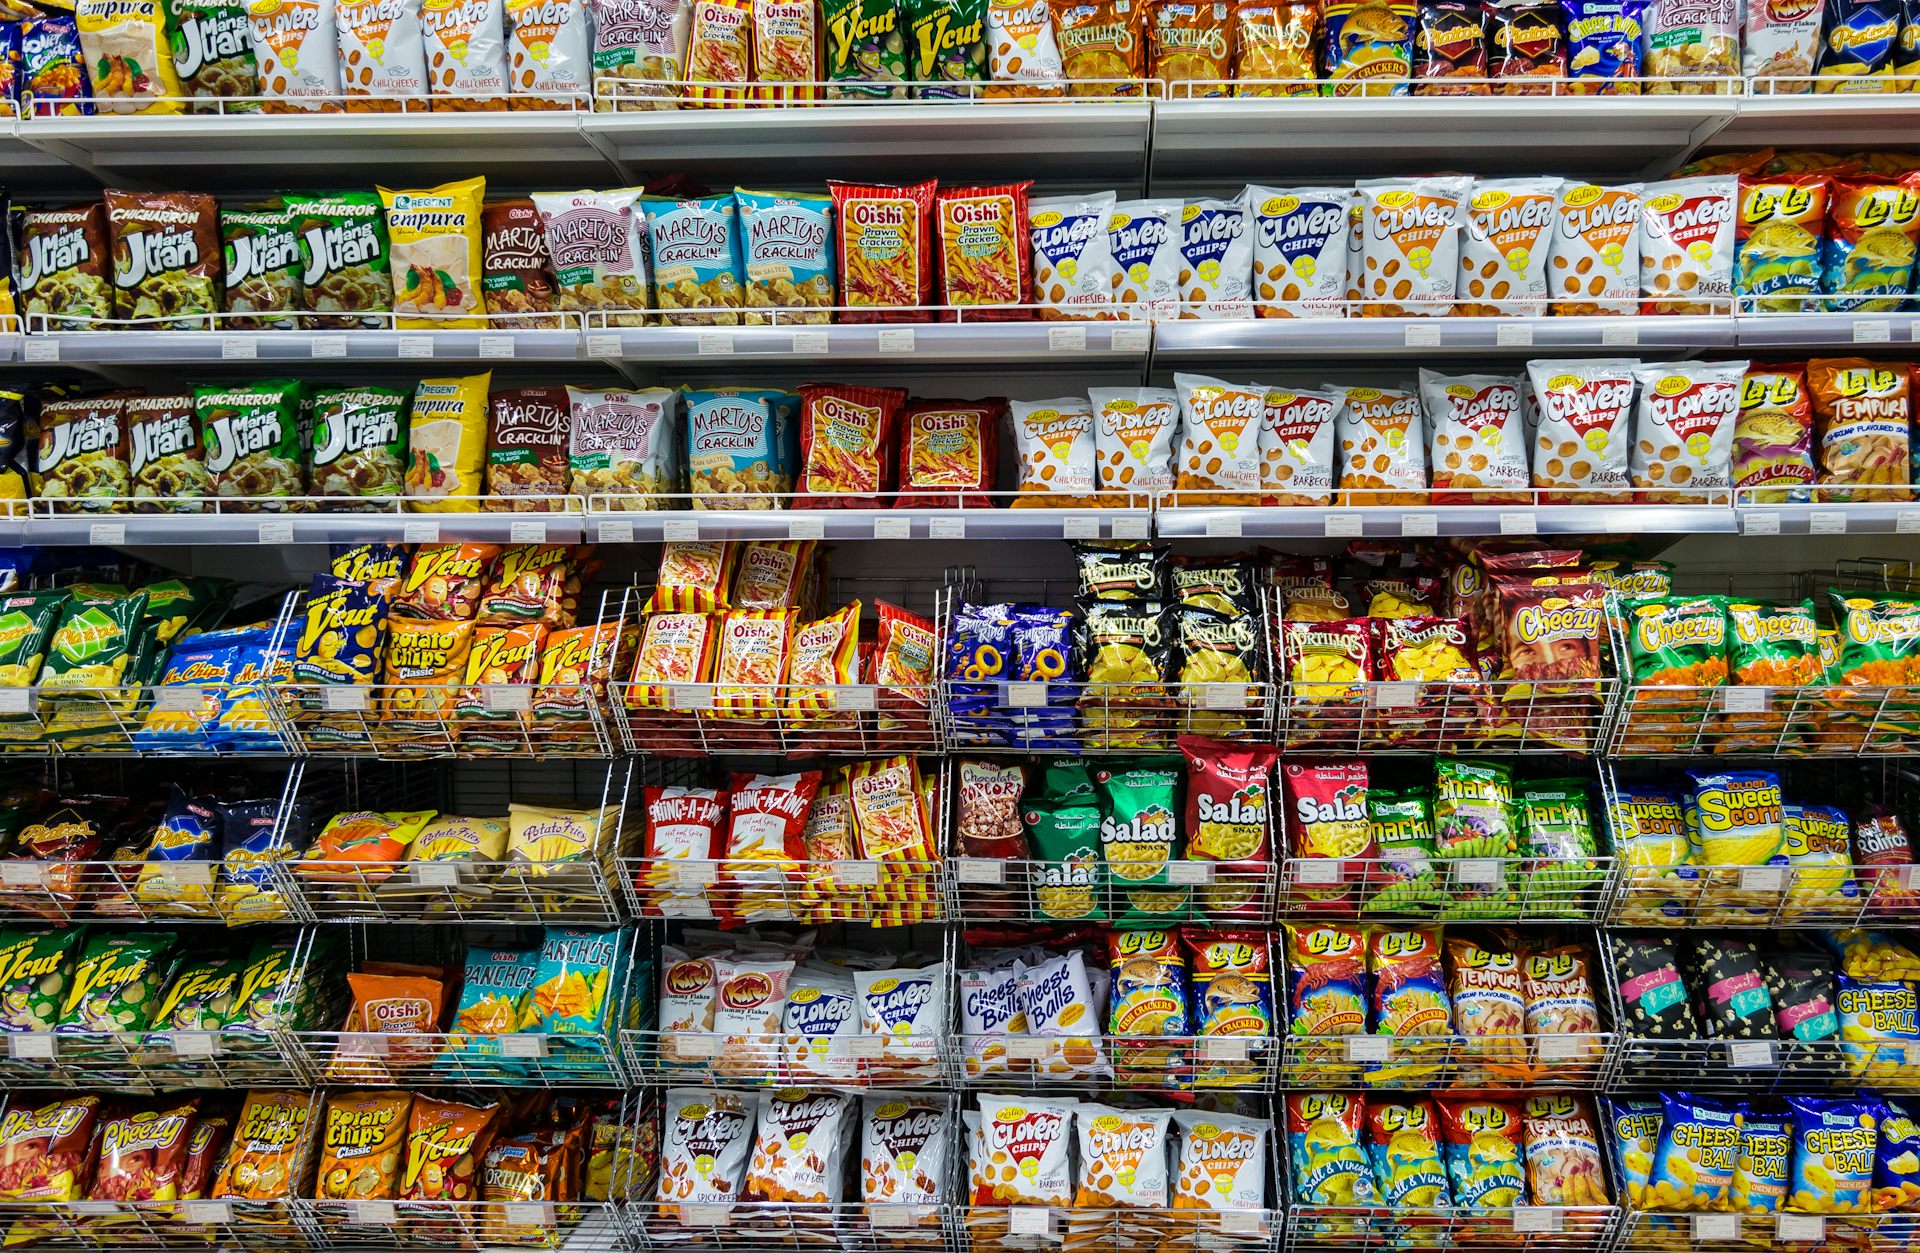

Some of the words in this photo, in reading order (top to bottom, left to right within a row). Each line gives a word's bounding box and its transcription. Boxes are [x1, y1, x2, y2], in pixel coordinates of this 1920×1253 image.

[703, 8, 742, 26] Oishi
[771, 20, 800, 30] Prawn
[1766, 21, 1791, 31] Yummy
[1793, 21, 1818, 29] Flakes
[251, 8, 322, 48] CLOVER
[356, 22, 391, 38] CHIPS
[441, 25, 474, 39] CHIPS
[519, 27, 558, 41] CHIPS
[709, 24, 736, 34] Prawn
[768, 29, 804, 39] Crackers
[703, 31, 740, 44] Crackers
[1057, 22, 1133, 58] TORTILLOS
[1357, 62, 1405, 82] CRACKERS
[110, 208, 200, 229] CHICHARRON
[854, 204, 904, 226] Oishi
[952, 203, 1000, 225] Oishi
[1470, 200, 1553, 243] CLOVER
[326, 224, 373, 248] Mang
[655, 215, 727, 244] MARTY'S
[752, 215, 825, 246] MARTY'S
[864, 226, 898, 239] Prawn
[962, 224, 996, 237] Prawn
[1257, 205, 1343, 249] CLOVER
[1397, 228, 1442, 243] CHIPS
[1587, 224, 1631, 243] CHIPS
[1672, 223, 1718, 243] CHIPS
[42, 229, 84, 250] Mang
[147, 233, 192, 252] Mang
[859, 236, 904, 248] Crackers
[957, 233, 1001, 245] Crackers
[1281, 237, 1325, 253] CHIPS
[1495, 229, 1538, 245] CHIPS
[658, 246, 722, 263] CRACKLIN'
[754, 246, 820, 262] CRACKLIN'
[1118, 247, 1157, 262] CHIPS
[1186, 241, 1228, 258] CHIPS
[196, 392, 284, 409] CHICHARRON
[1650, 386, 1737, 426] CLOVER
[1830, 397, 1906, 422] TEMPURA
[693, 406, 763, 434] MARTY'S
[823, 401, 871, 428] Oishi
[1190, 395, 1264, 427] CLOVER
[1348, 398, 1420, 426] CLOVER
[149, 415, 191, 439] Mang
[233, 411, 278, 437] Mang
[831, 420, 862, 436] Prawn
[922, 415, 967, 431] Oishi
[1023, 413, 1094, 440] CLOVER
[1101, 407, 1172, 438] CLOVER
[1209, 418, 1247, 430] CHIPS
[1371, 415, 1410, 427] CHIPS
[1674, 415, 1719, 433] CHIPS
[1857, 424, 1895, 435] FLAVOURED
[497, 432, 567, 447] CRACKLIN'
[931, 431, 962, 441] Prawn
[1043, 430, 1080, 441] CHIPS
[1120, 427, 1158, 439] CHIPS
[1279, 424, 1318, 437] CHIPS
[696, 436, 759, 450] CRACKLIN'
[703, 456, 730, 468] SALTED
[1771, 461, 1806, 478] Chili
[500, 545, 568, 589] Vcut
[749, 550, 787, 571] Oishi
[406, 551, 483, 592] Vcut
[747, 574, 780, 585] Crackers
[752, 567, 778, 578] Prawn
[296, 594, 379, 658] Vcut
[656, 618, 694, 633] Oishi
[733, 623, 772, 639] Oishi
[1515, 603, 1602, 646] Cheezy
[1734, 608, 1818, 646] Cheezy
[391, 631, 456, 651] Potato
[799, 628, 835, 647] Oishi
[902, 625, 934, 647] Oishi
[1384, 622, 1467, 653] TORTILLOS
[1637, 613, 1725, 655] Cheezy
[899, 645, 931, 663] Crackers
[1284, 630, 1369, 661] TORTILLOS
[391, 647, 449, 669] Chips
[182, 662, 230, 685] Chips
[399, 664, 435, 679] Classic
[963, 769, 1023, 786] Chocolate
[1466, 766, 1497, 777] REGENT
[860, 773, 900, 794] Oishi
[1726, 780, 1768, 791] GOLDEN
[731, 786, 810, 818] SHING-A-LING
[867, 797, 904, 812] Crackers
[870, 790, 899, 803] Prawn
[1198, 794, 1269, 825] Salad
[1698, 785, 1782, 832] Sweet
[1730, 804, 1783, 827] corn
[522, 820, 564, 849] Potato
[562, 818, 589, 848] Fries
[1100, 816, 1177, 844] Salad
[1232, 826, 1263, 835] SNACK
[419, 829, 458, 854] Potato
[457, 825, 482, 844] Fries
[674, 836, 692, 845] Flavor
[1135, 844, 1168, 852] SNACK
[492, 951, 518, 963] Oishi
[66, 955, 148, 1014] Vcut
[1460, 968, 1523, 991] TEMPURA
[1635, 972, 1668, 993] Sweet
[1725, 971, 1755, 993] Sweet
[687, 993, 710, 1001] Flakes
[866, 983, 934, 1019] CLOVER
[1479, 991, 1512, 1001] FLAVOURED
[1838, 989, 1918, 1013] CHEESE
[375, 1003, 422, 1020] Oishi
[746, 1008, 770, 1016] Flakes
[787, 1000, 852, 1029] CLOVER
[1031, 983, 1076, 1034] Balls
[1119, 1014, 1137, 1033] FISH
[1133, 1000, 1176, 1019] CRACKERS
[1788, 1000, 1820, 1023] Sweet
[383, 1020, 416, 1029] Prawn
[553, 1020, 575, 1034] TACO
[804, 1021, 838, 1034] CHIPS
[1874, 1012, 1919, 1033] BALL
[330, 1107, 395, 1128] Potato
[766, 1093, 840, 1126] CLOVER
[1704, 1111, 1731, 1122] REGENT
[870, 1112, 942, 1146] CLOVER
[1749, 1122, 1780, 1131] REGENT
[1832, 1115, 1857, 1126] REGENT
[101, 1113, 187, 1160] Cheezy
[326, 1123, 386, 1149] Chips
[992, 1116, 1062, 1150] CLOVER
[247, 1140, 285, 1153] Classic
[888, 1136, 927, 1149] CHIPS
[1011, 1141, 1047, 1155] CHIPS
[1188, 1136, 1256, 1165] CLOVER
[335, 1144, 372, 1160] Classic
[1206, 1159, 1242, 1172] CHIPS
[1336, 1159, 1376, 1180] Vinegar
[697, 1192, 717, 1204] SPICY
[717, 1193, 737, 1205] BEEF
[902, 1192, 922, 1205] SPICY
[923, 1193, 942, 1205] BEEF
